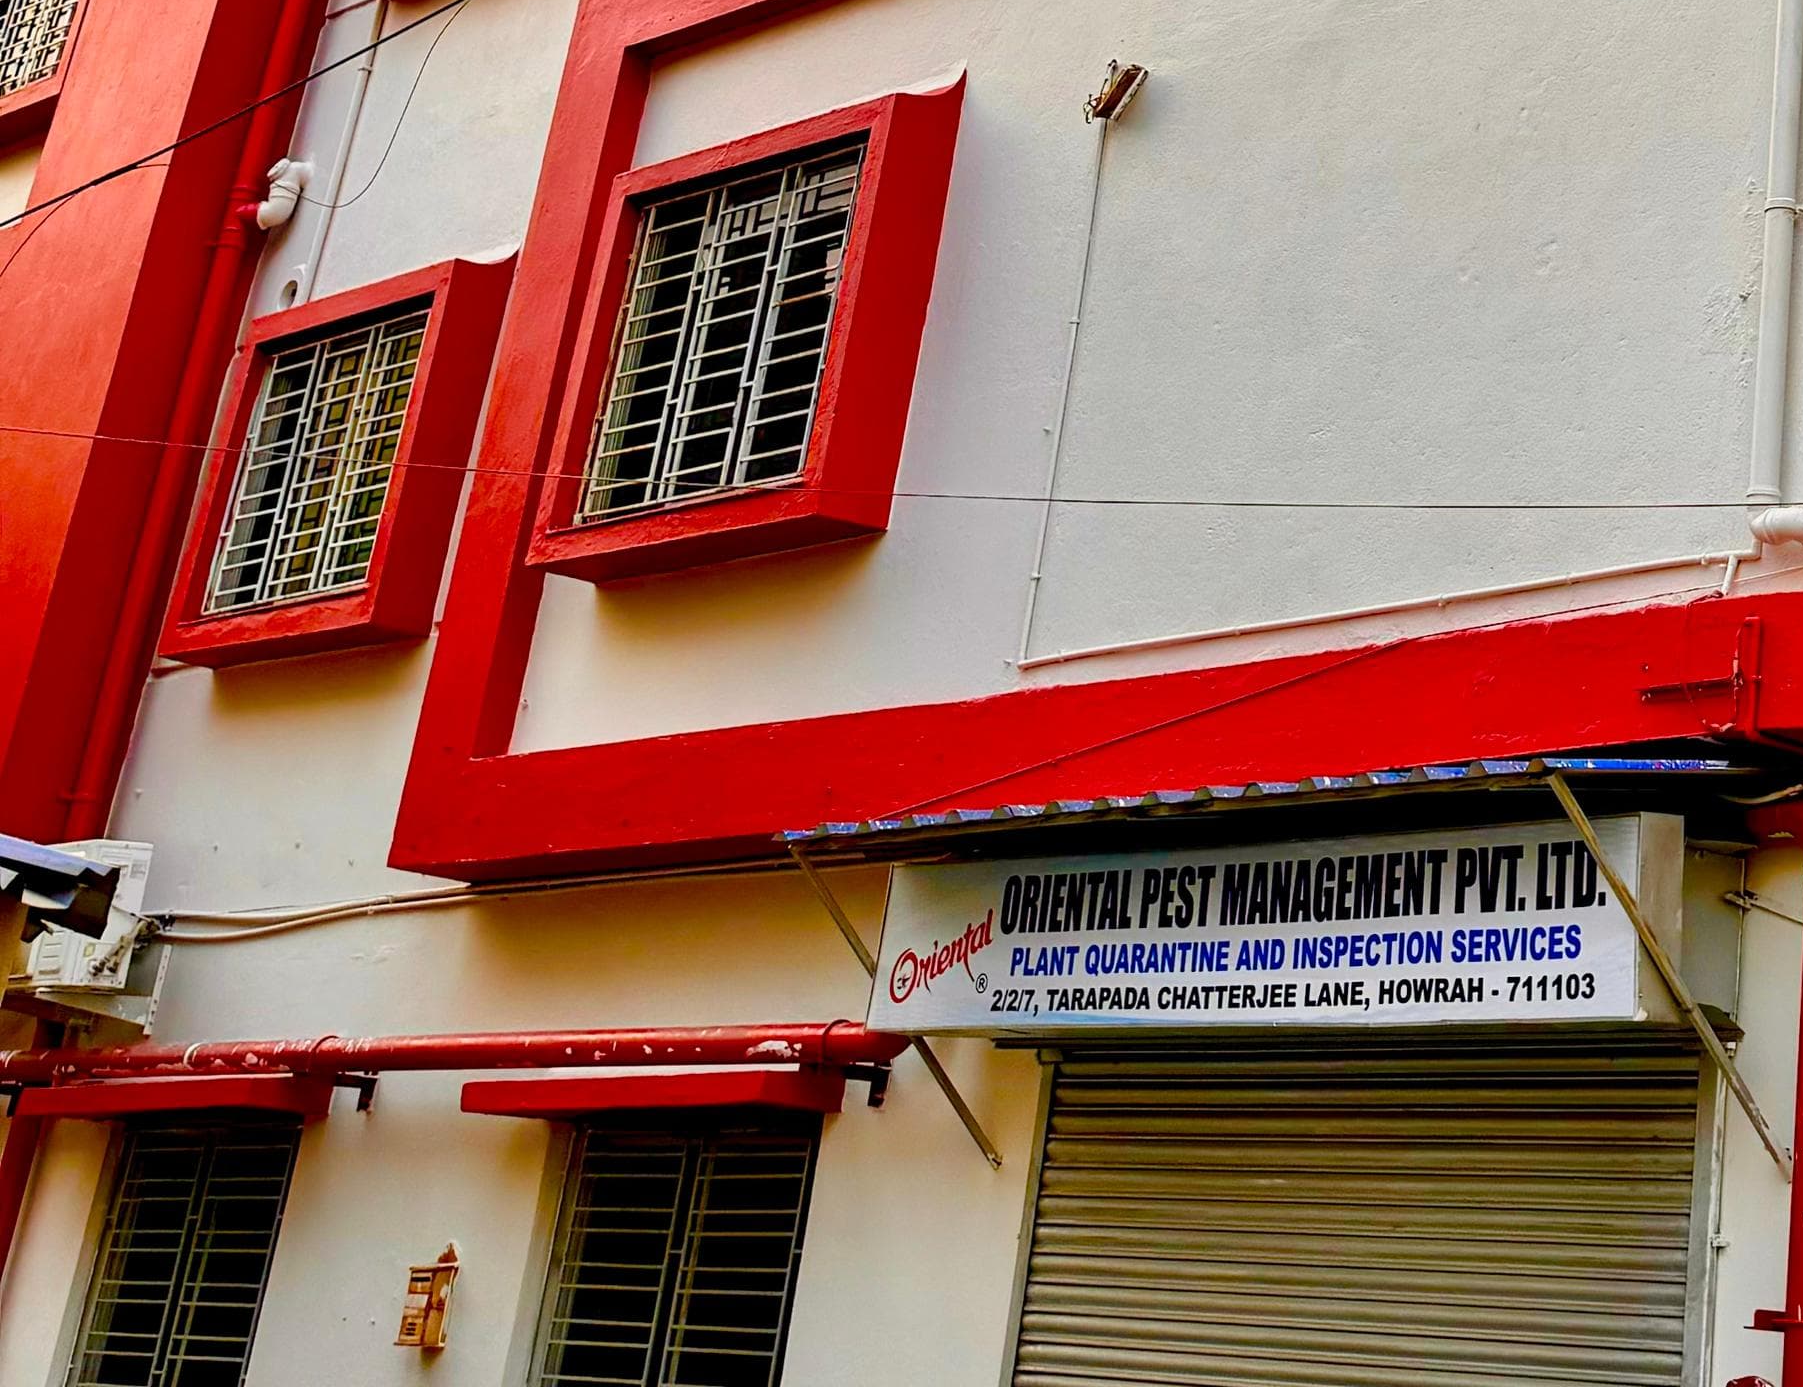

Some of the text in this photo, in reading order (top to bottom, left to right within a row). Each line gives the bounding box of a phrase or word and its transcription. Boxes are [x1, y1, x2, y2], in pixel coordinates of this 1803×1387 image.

[1000, 840, 1607, 936] ORIENTAL PEST MANAGEMENT PVT. LTD.
[889, 908, 994, 1004] Oriental
[1010, 924, 1582, 977] PLANT QUARANTINE AND INSPECTION SERVICES
[990, 988, 1040, 1017] 2/2/7,
[1047, 986, 1151, 1011] TARAPADA
[1157, 983, 1298, 1010] CHATTERJEE
[1304, 981, 1371, 1011] LANE,
[1378, 977, 1484, 1006] HOWRAH
[1507, 972, 1596, 1002] 711103
